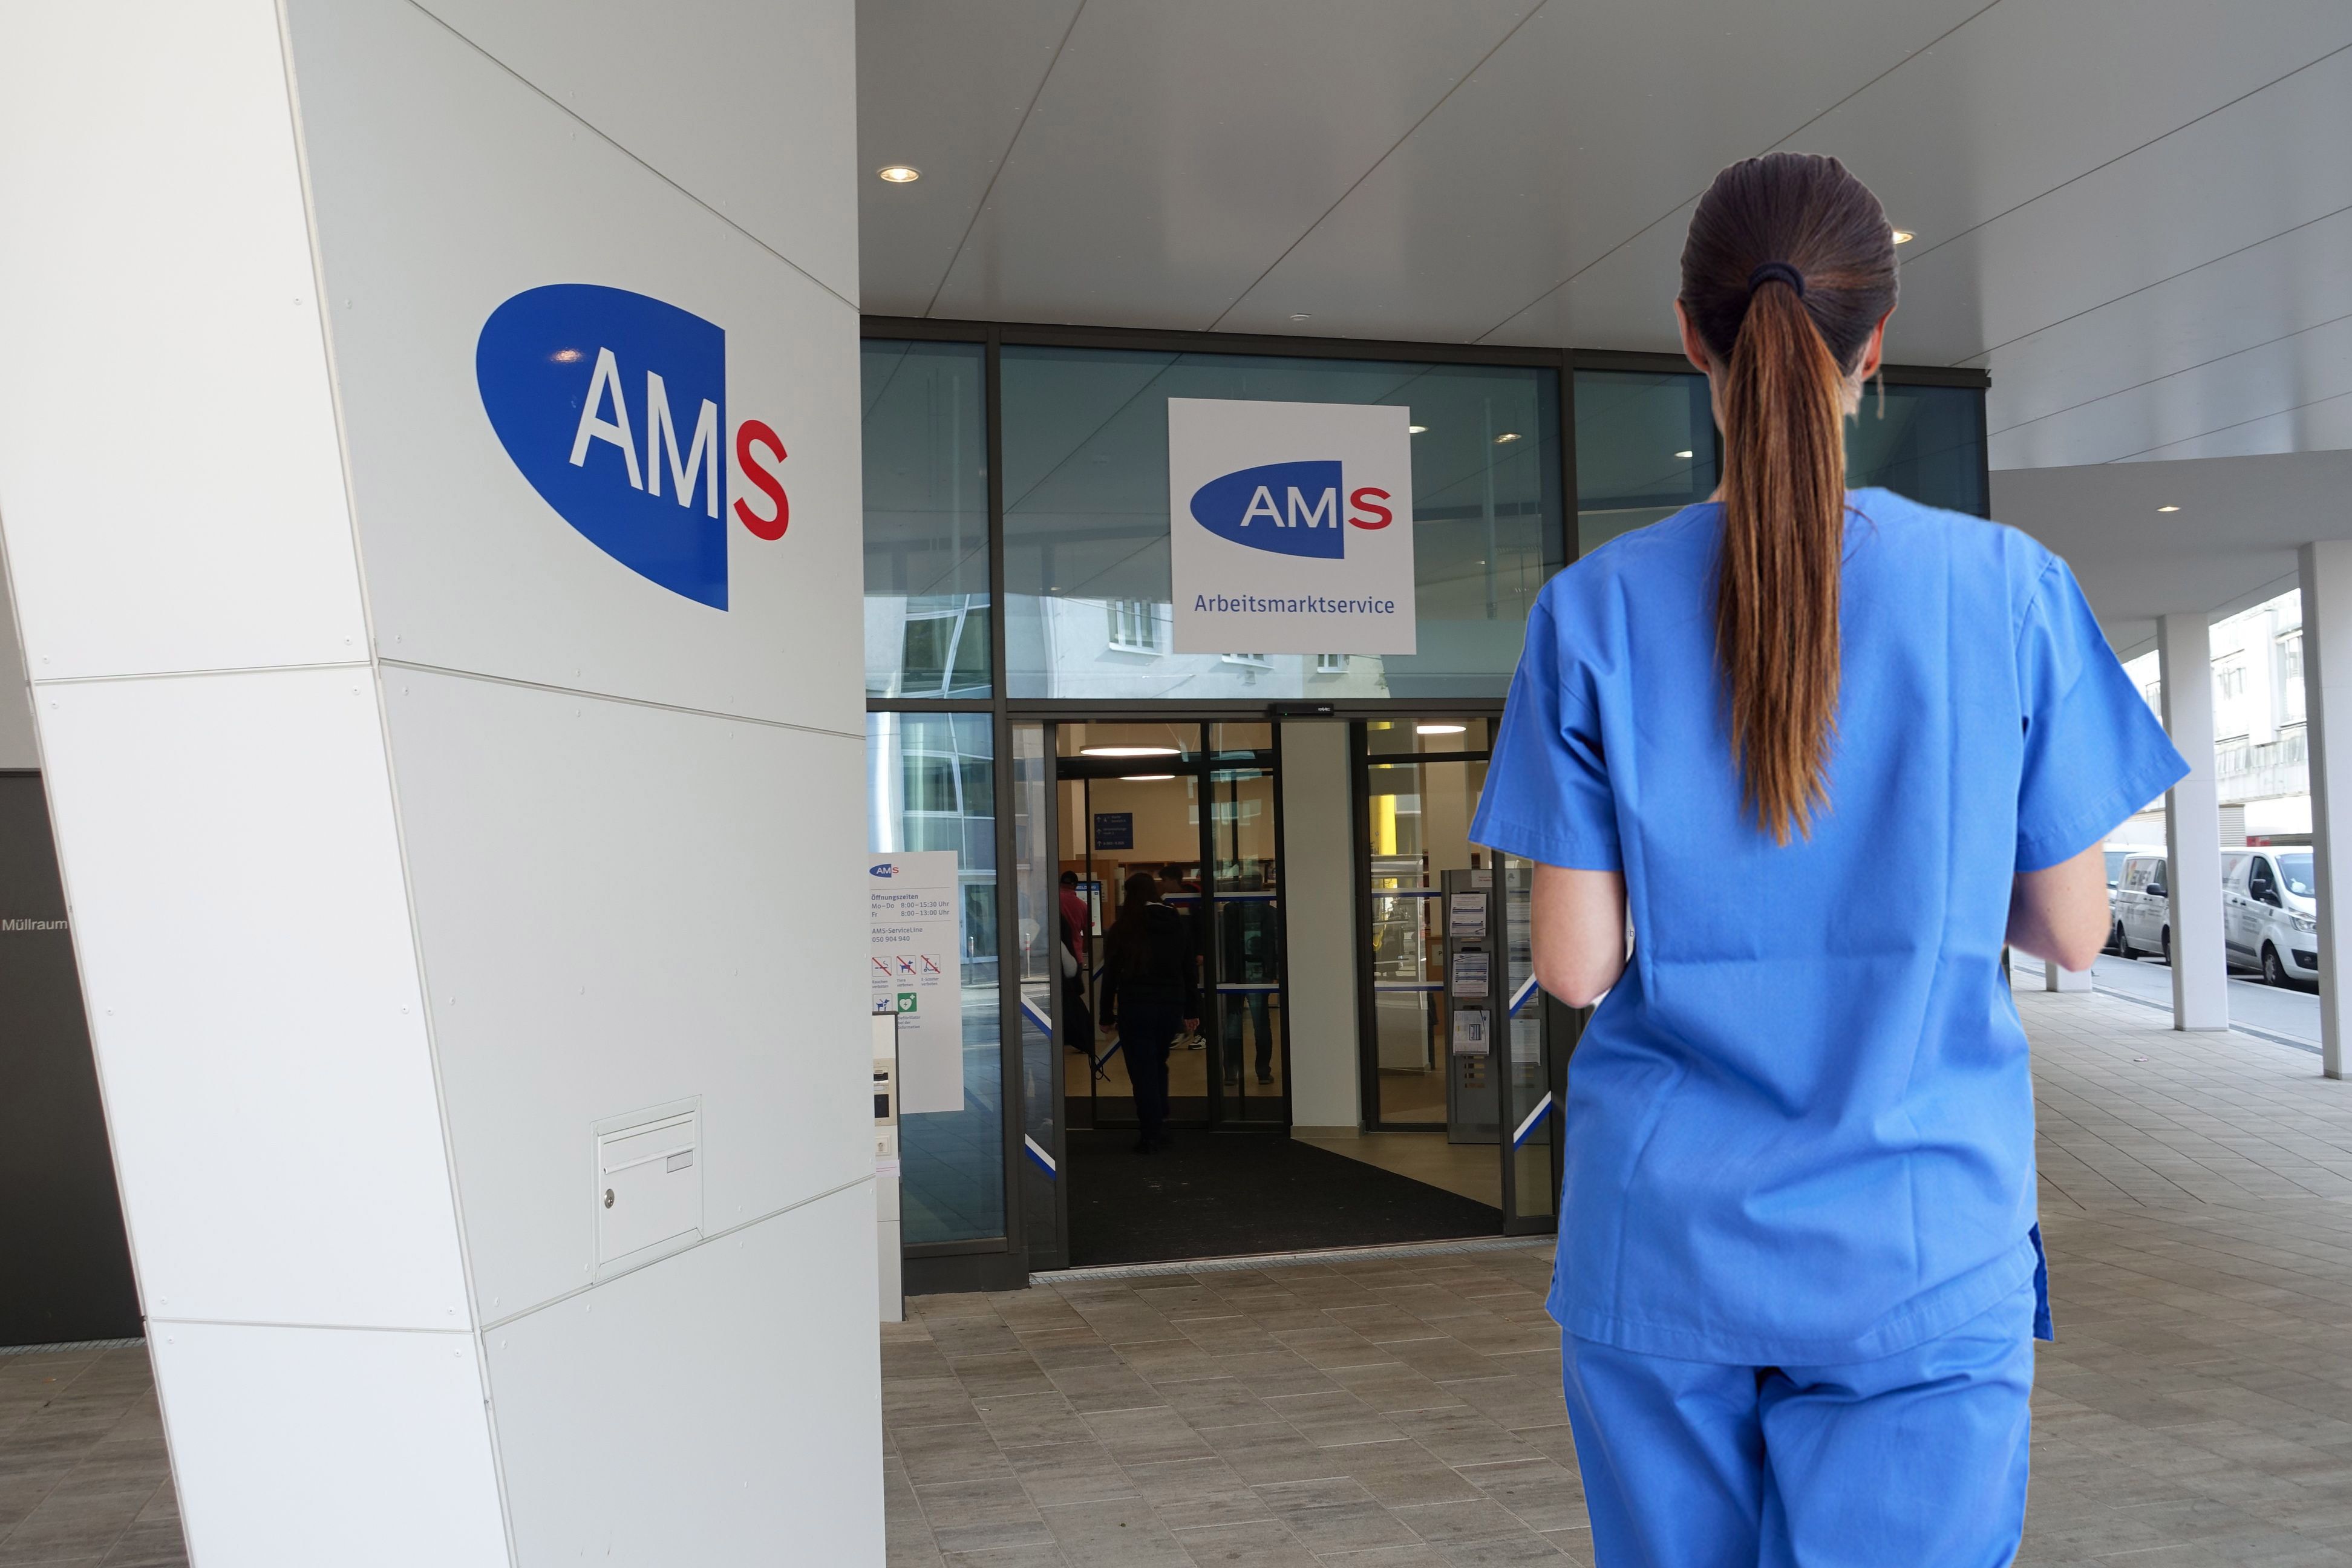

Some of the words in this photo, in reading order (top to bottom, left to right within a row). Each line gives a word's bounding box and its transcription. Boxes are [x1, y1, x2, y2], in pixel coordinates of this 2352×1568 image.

[569, 346, 789, 541] AMS
[1240, 485, 1393, 531] AMS
[1194, 594, 1394, 613] Arbeitsmarktservice
[2, 918, 68, 931] Müllraum
